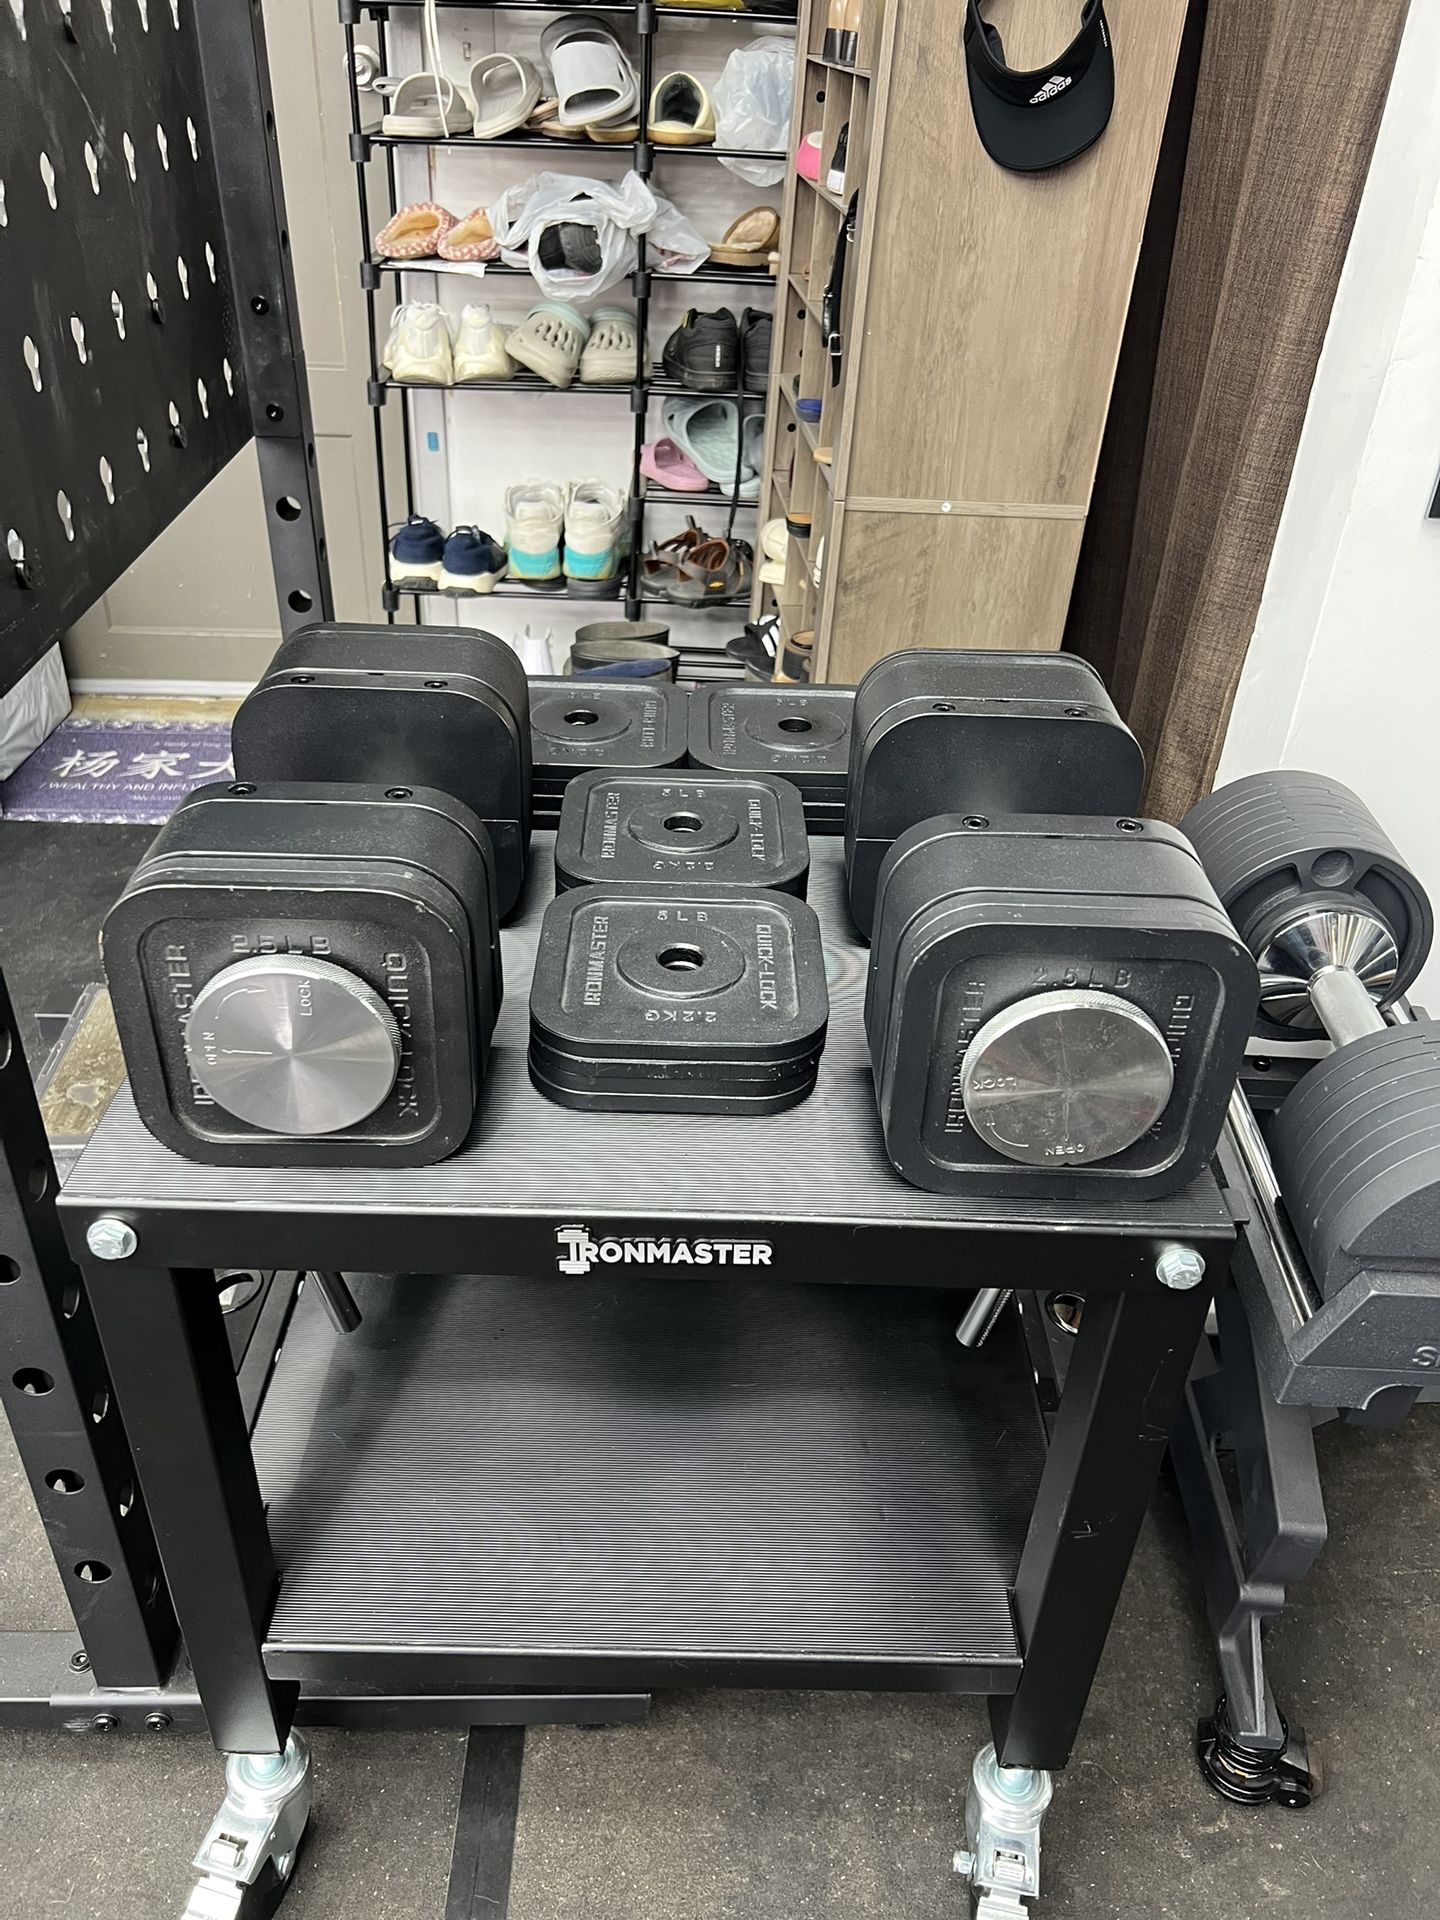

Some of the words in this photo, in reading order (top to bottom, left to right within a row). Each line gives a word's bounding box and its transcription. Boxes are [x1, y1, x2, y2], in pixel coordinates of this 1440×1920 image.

[1029, 76, 1073, 104] adidas
[122, 781, 155, 791] AND
[583, 915, 609, 1006] IRONMASTER
[756, 924, 778, 1010] QUICK-LOCK
[298, 979, 313, 1016] LOCK
[972, 1077, 1017, 1090] LOCK
[1044, 1143, 1086, 1156] OPEN
[557, 1228, 773, 1275] IRONMASTER
